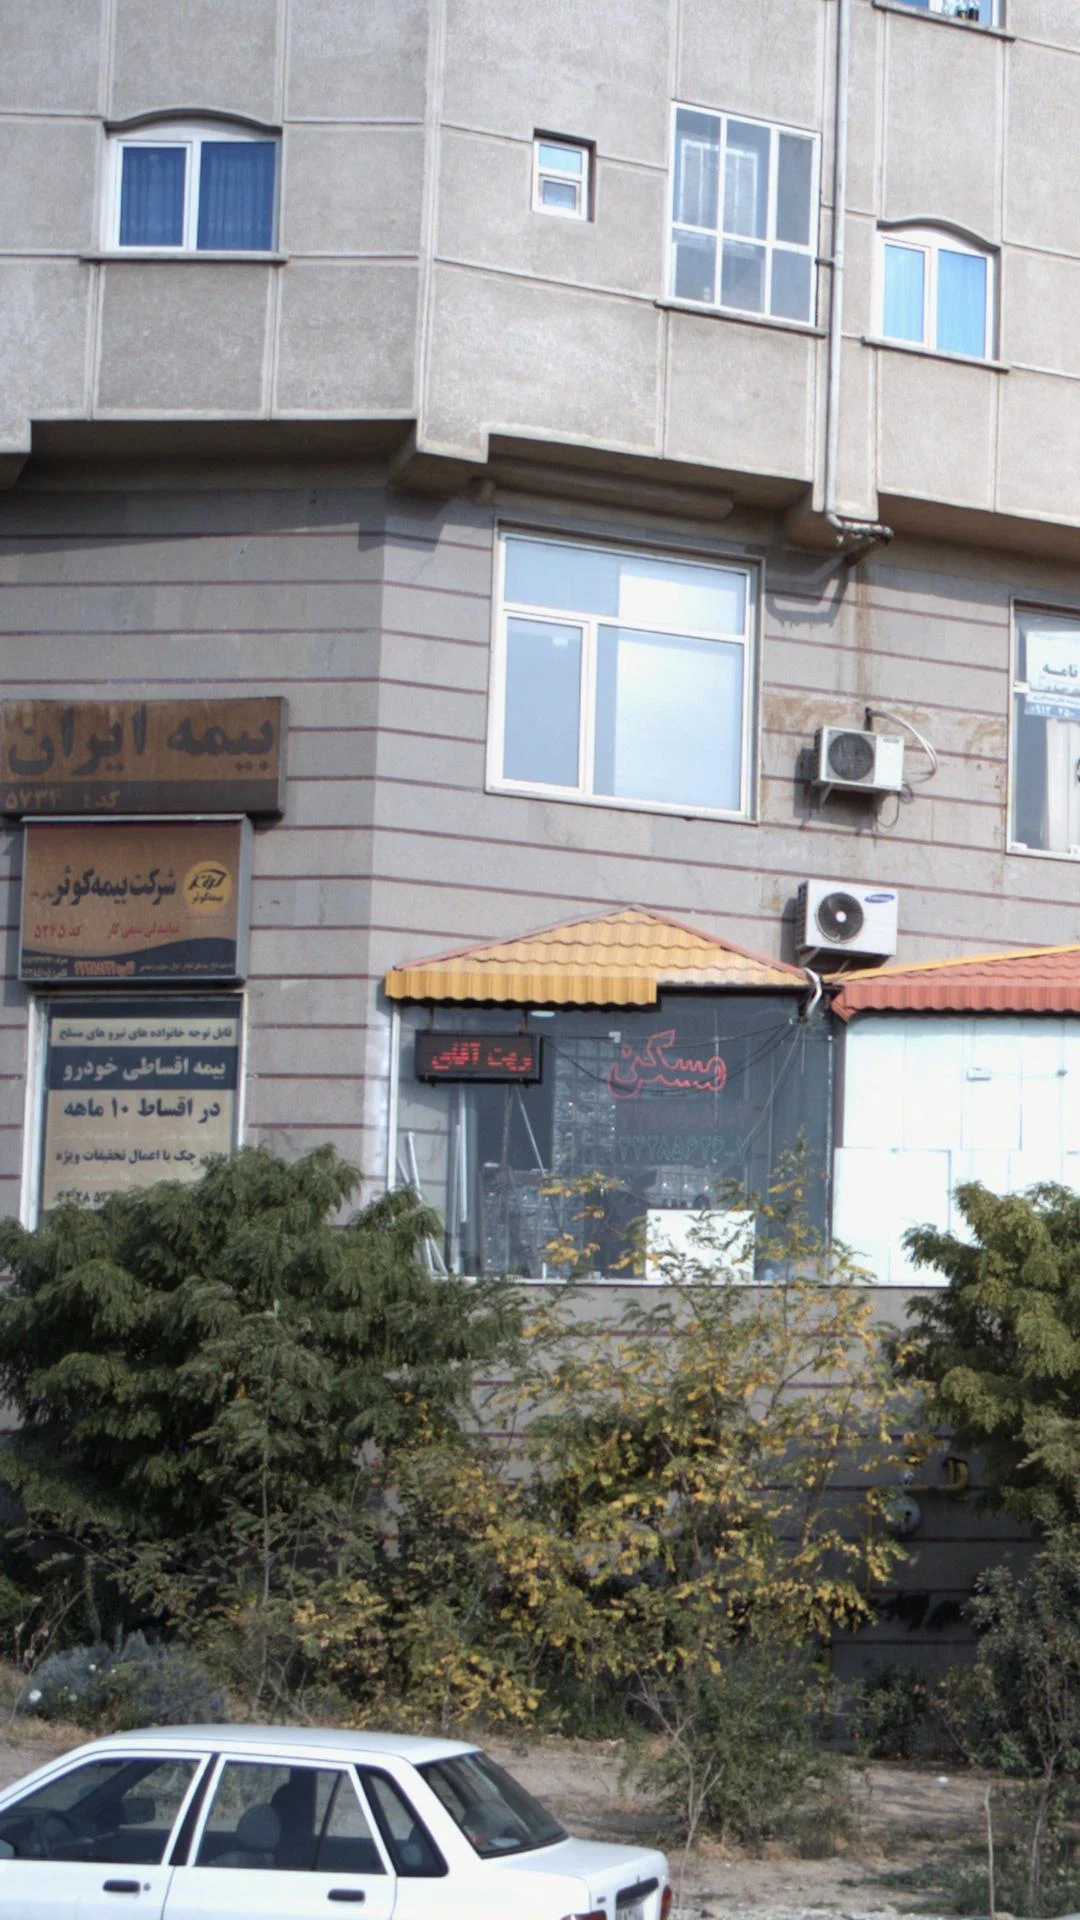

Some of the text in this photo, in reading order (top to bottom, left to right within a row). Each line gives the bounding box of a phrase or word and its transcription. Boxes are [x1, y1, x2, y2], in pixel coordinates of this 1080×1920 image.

[8, 703, 274, 776] بیمه ایران
[51, 864, 176, 906] شرکت بیمه کوثر
[62, 1056, 226, 1081] بیمه اقساطی خودرو
[607, 1029, 728, 1099] مسکن
[64, 1098, 104, 1117] ماهه
[137, 1096, 193, 1117] اقساط
[197, 1101, 221, 1123] در
[129, 1149, 160, 1164] اعمال
